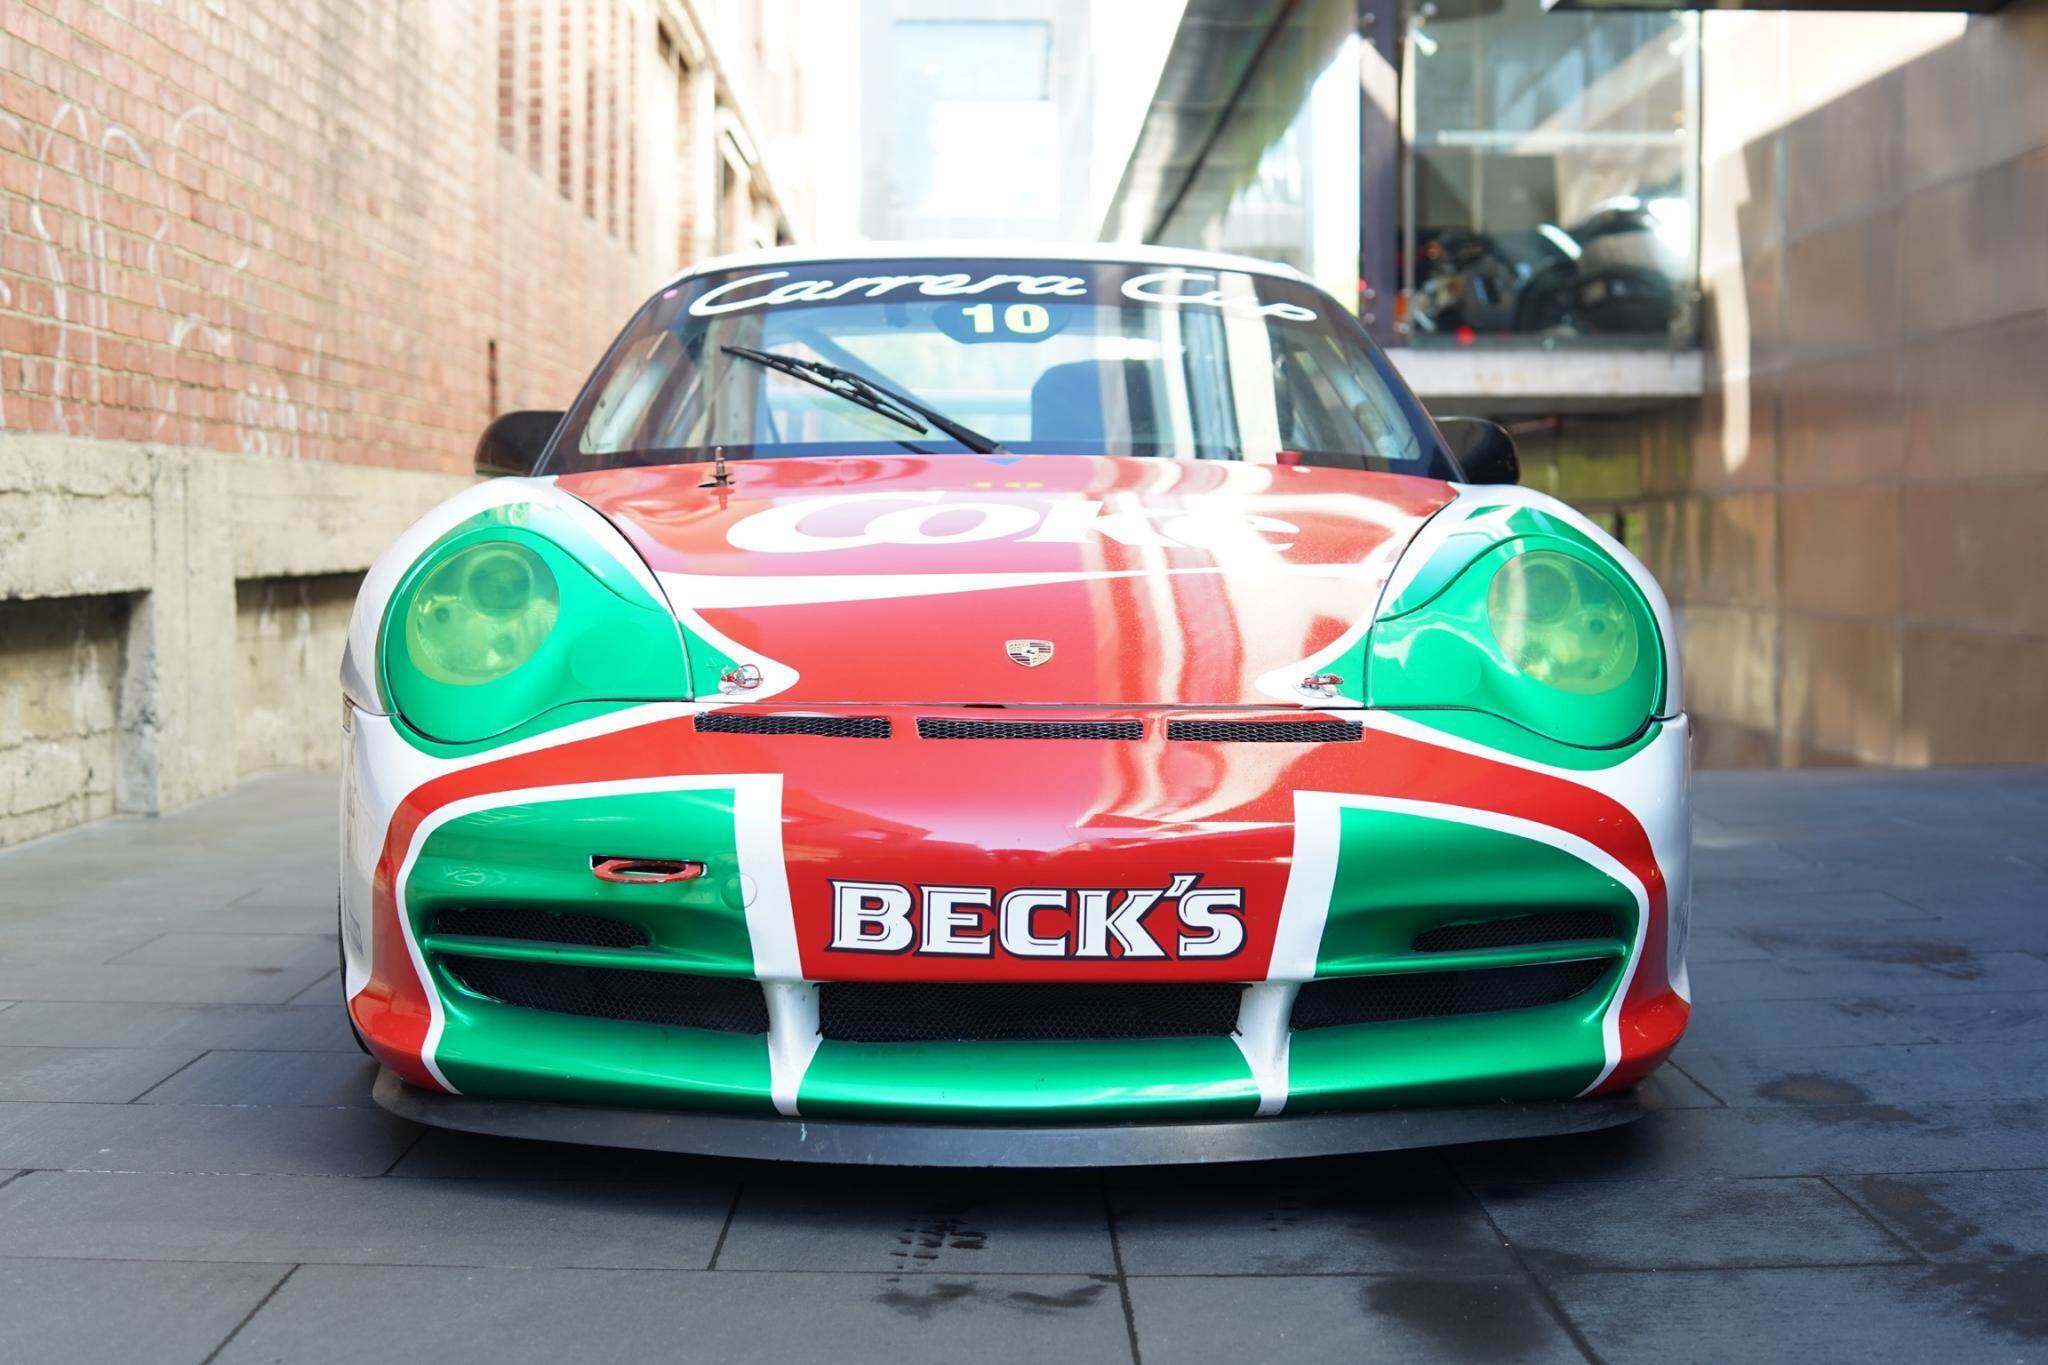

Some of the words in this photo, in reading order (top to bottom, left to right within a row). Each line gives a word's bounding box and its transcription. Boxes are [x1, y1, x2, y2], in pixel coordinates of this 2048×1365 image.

[688, 271, 1088, 316] Carrera
[962, 303, 1050, 334] 10
[825, 872, 1248, 961] BECK'S
